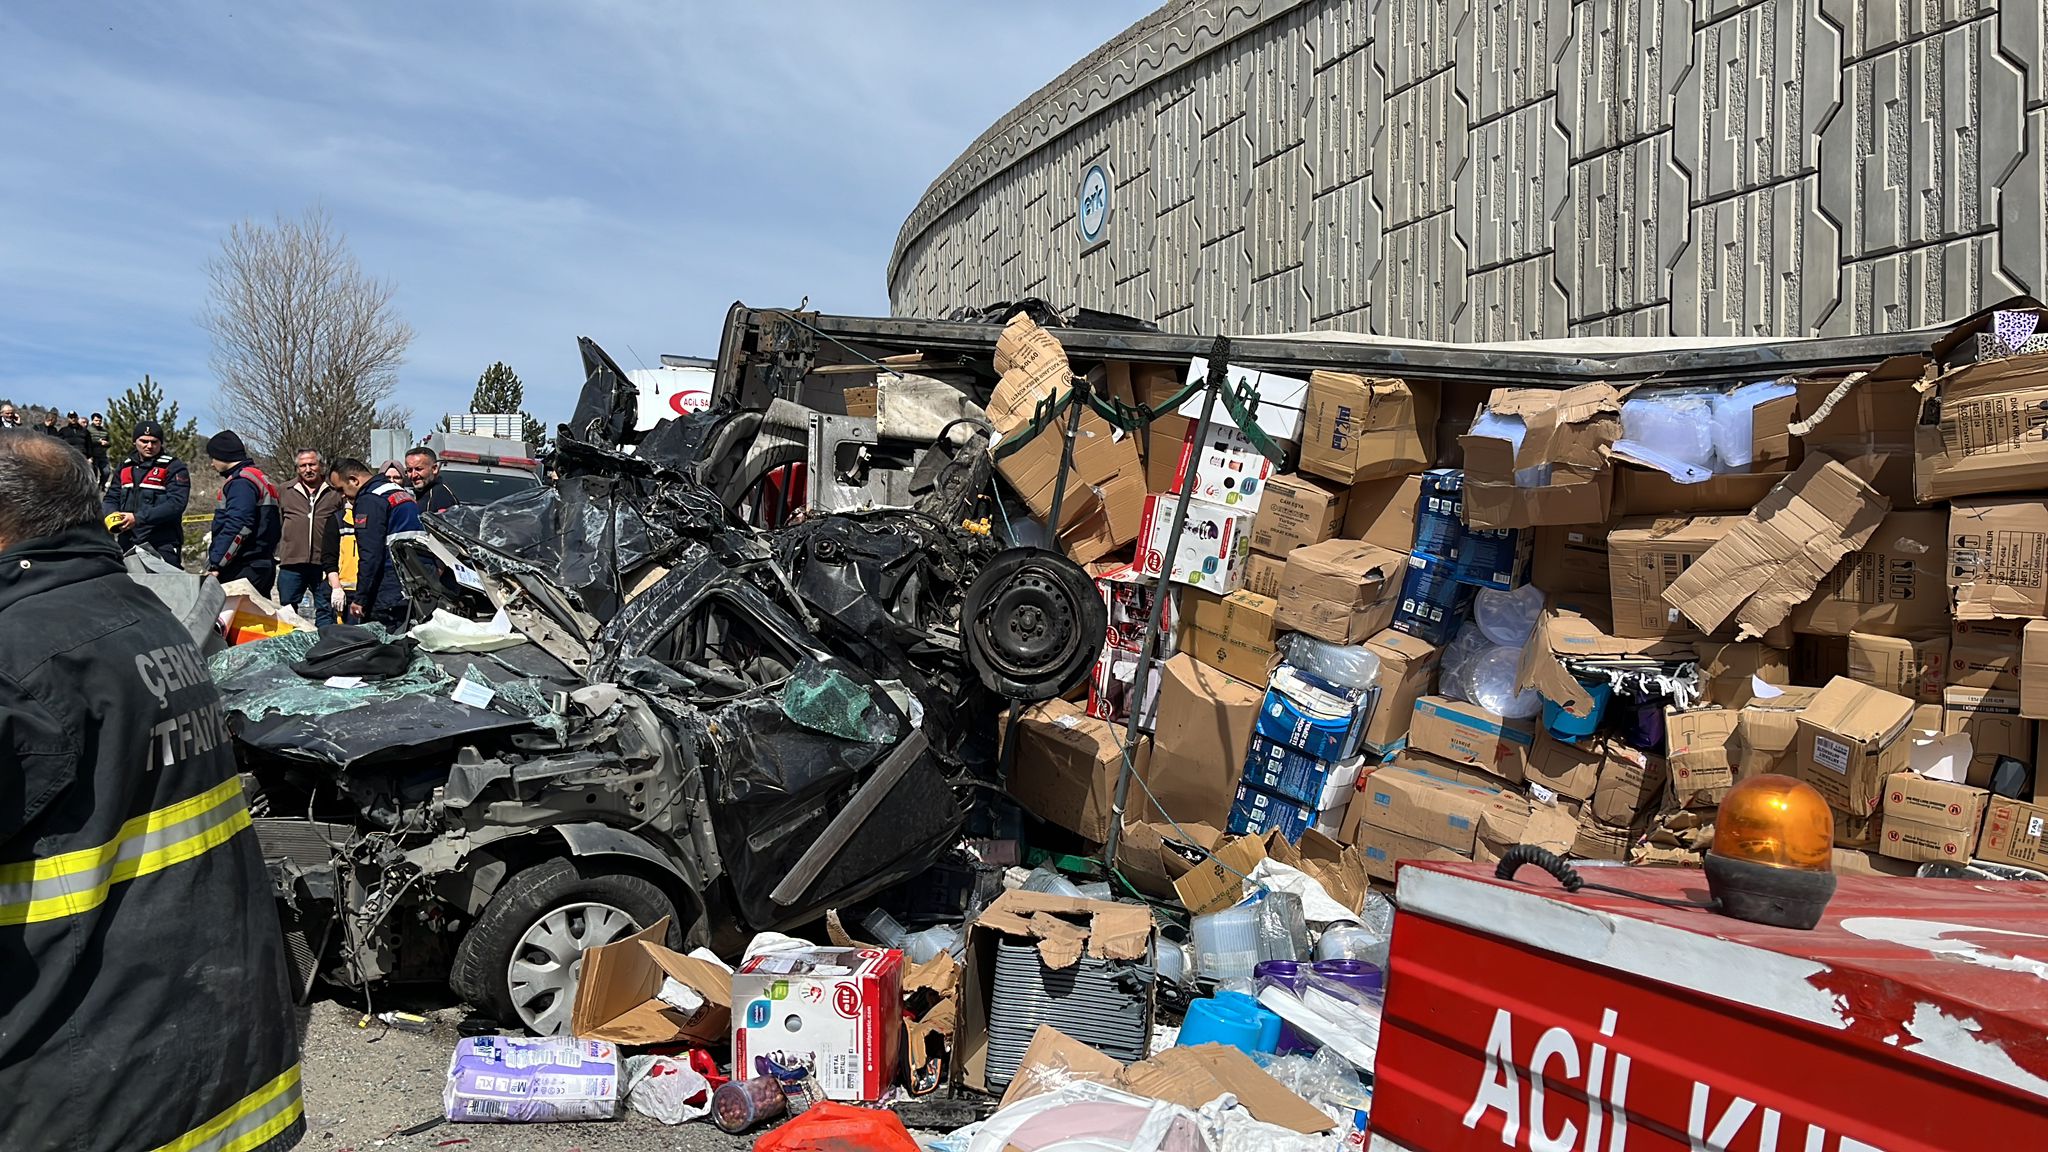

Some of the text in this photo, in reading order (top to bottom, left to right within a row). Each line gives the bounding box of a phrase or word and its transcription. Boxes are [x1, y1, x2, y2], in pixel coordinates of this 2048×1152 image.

[1083, 184, 1103, 216] erk
[842, 989, 851, 1012] elif
[1462, 1007, 1631, 1152] ACİL
